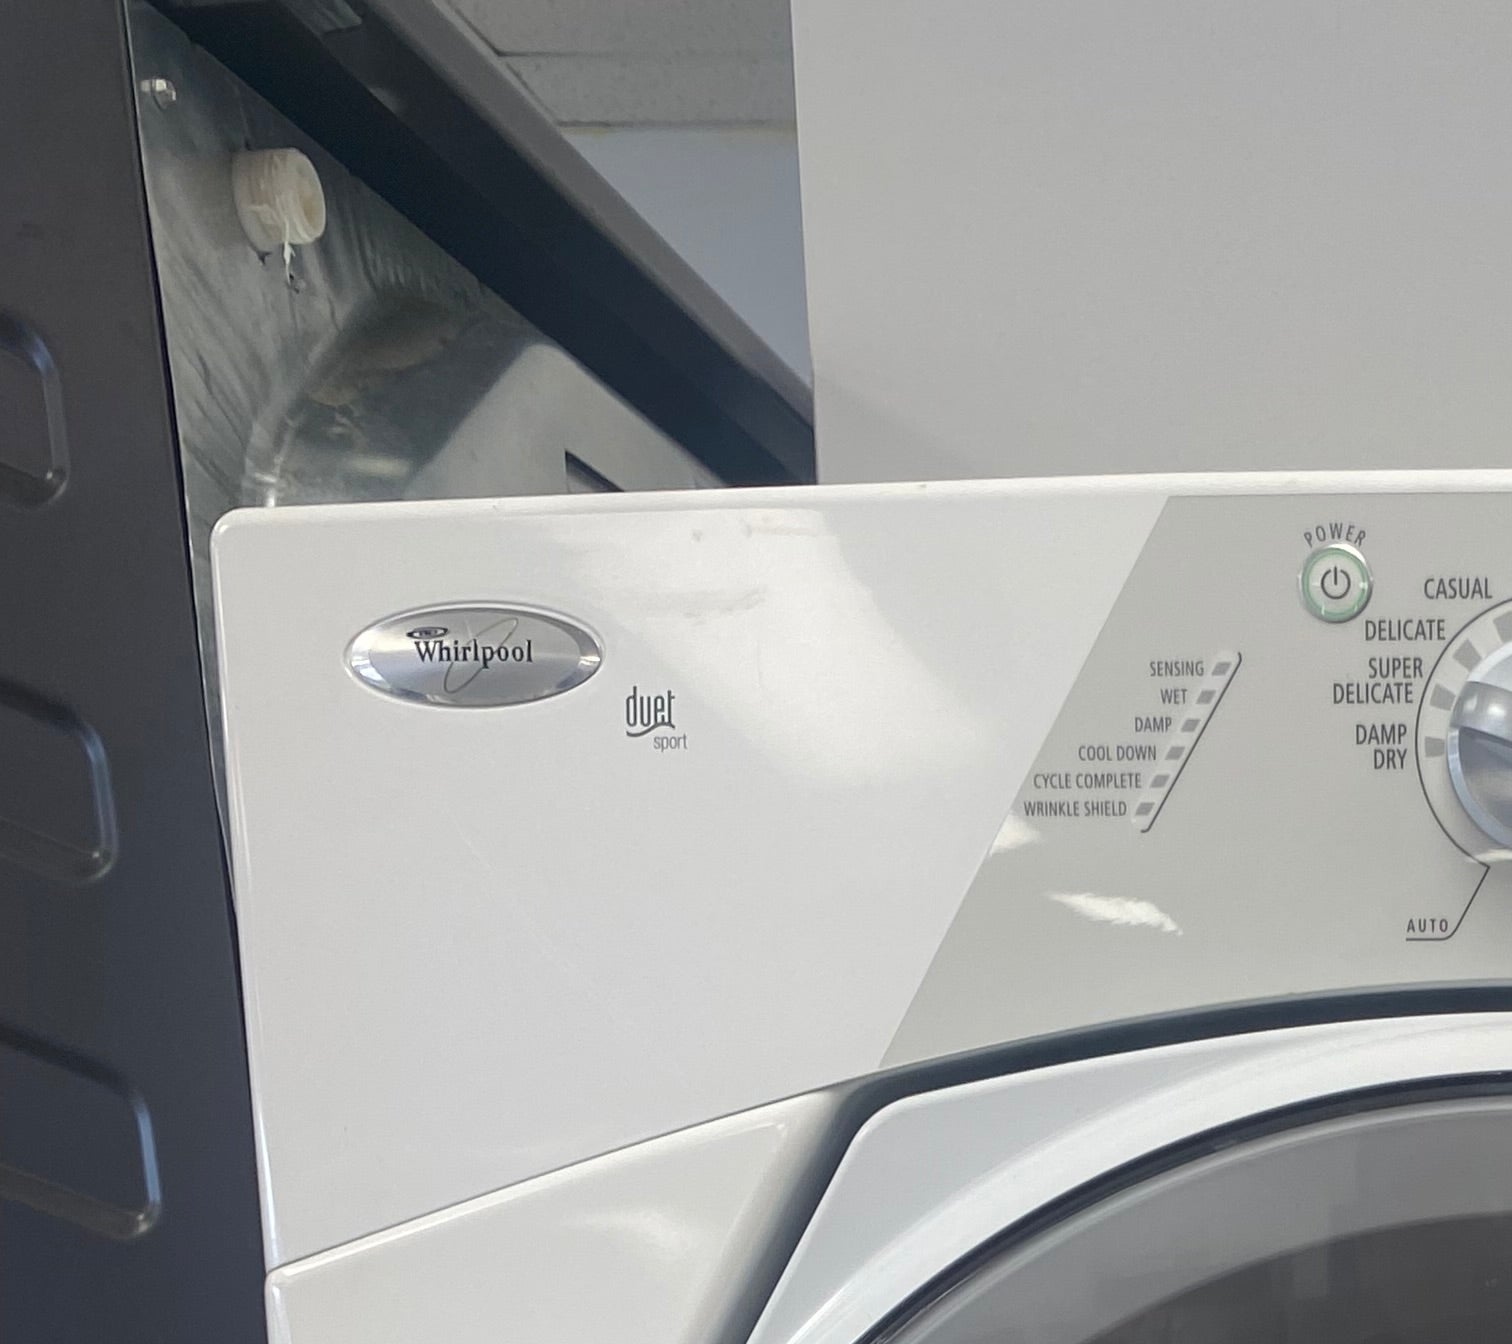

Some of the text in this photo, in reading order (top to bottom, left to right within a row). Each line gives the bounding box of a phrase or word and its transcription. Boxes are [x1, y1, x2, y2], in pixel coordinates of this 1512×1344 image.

[1303, 522, 1367, 547] POWER
[1424, 577, 1493, 599] CASUAL
[1365, 619, 1446, 642] DELICATE
[414, 640, 533, 669] Whirlpool
[1150, 661, 1204, 677] SENSING
[1368, 657, 1423, 679] SUPER
[1161, 689, 1187, 705] WET
[1333, 683, 1414, 705] DELICATE
[625, 686, 675, 737] duet
[1135, 717, 1172, 732] DAMP
[1355, 724, 1407, 745] DAMP
[653, 733, 688, 753] sport
[1078, 745, 1157, 761] COOL DOWN
[1373, 748, 1408, 770] DRY
[1034, 773, 1141, 789] CYCLE COMPLETE
[1024, 801, 1127, 817] WRINKLE SHIELD
[1406, 918, 1449, 934] AUTO
